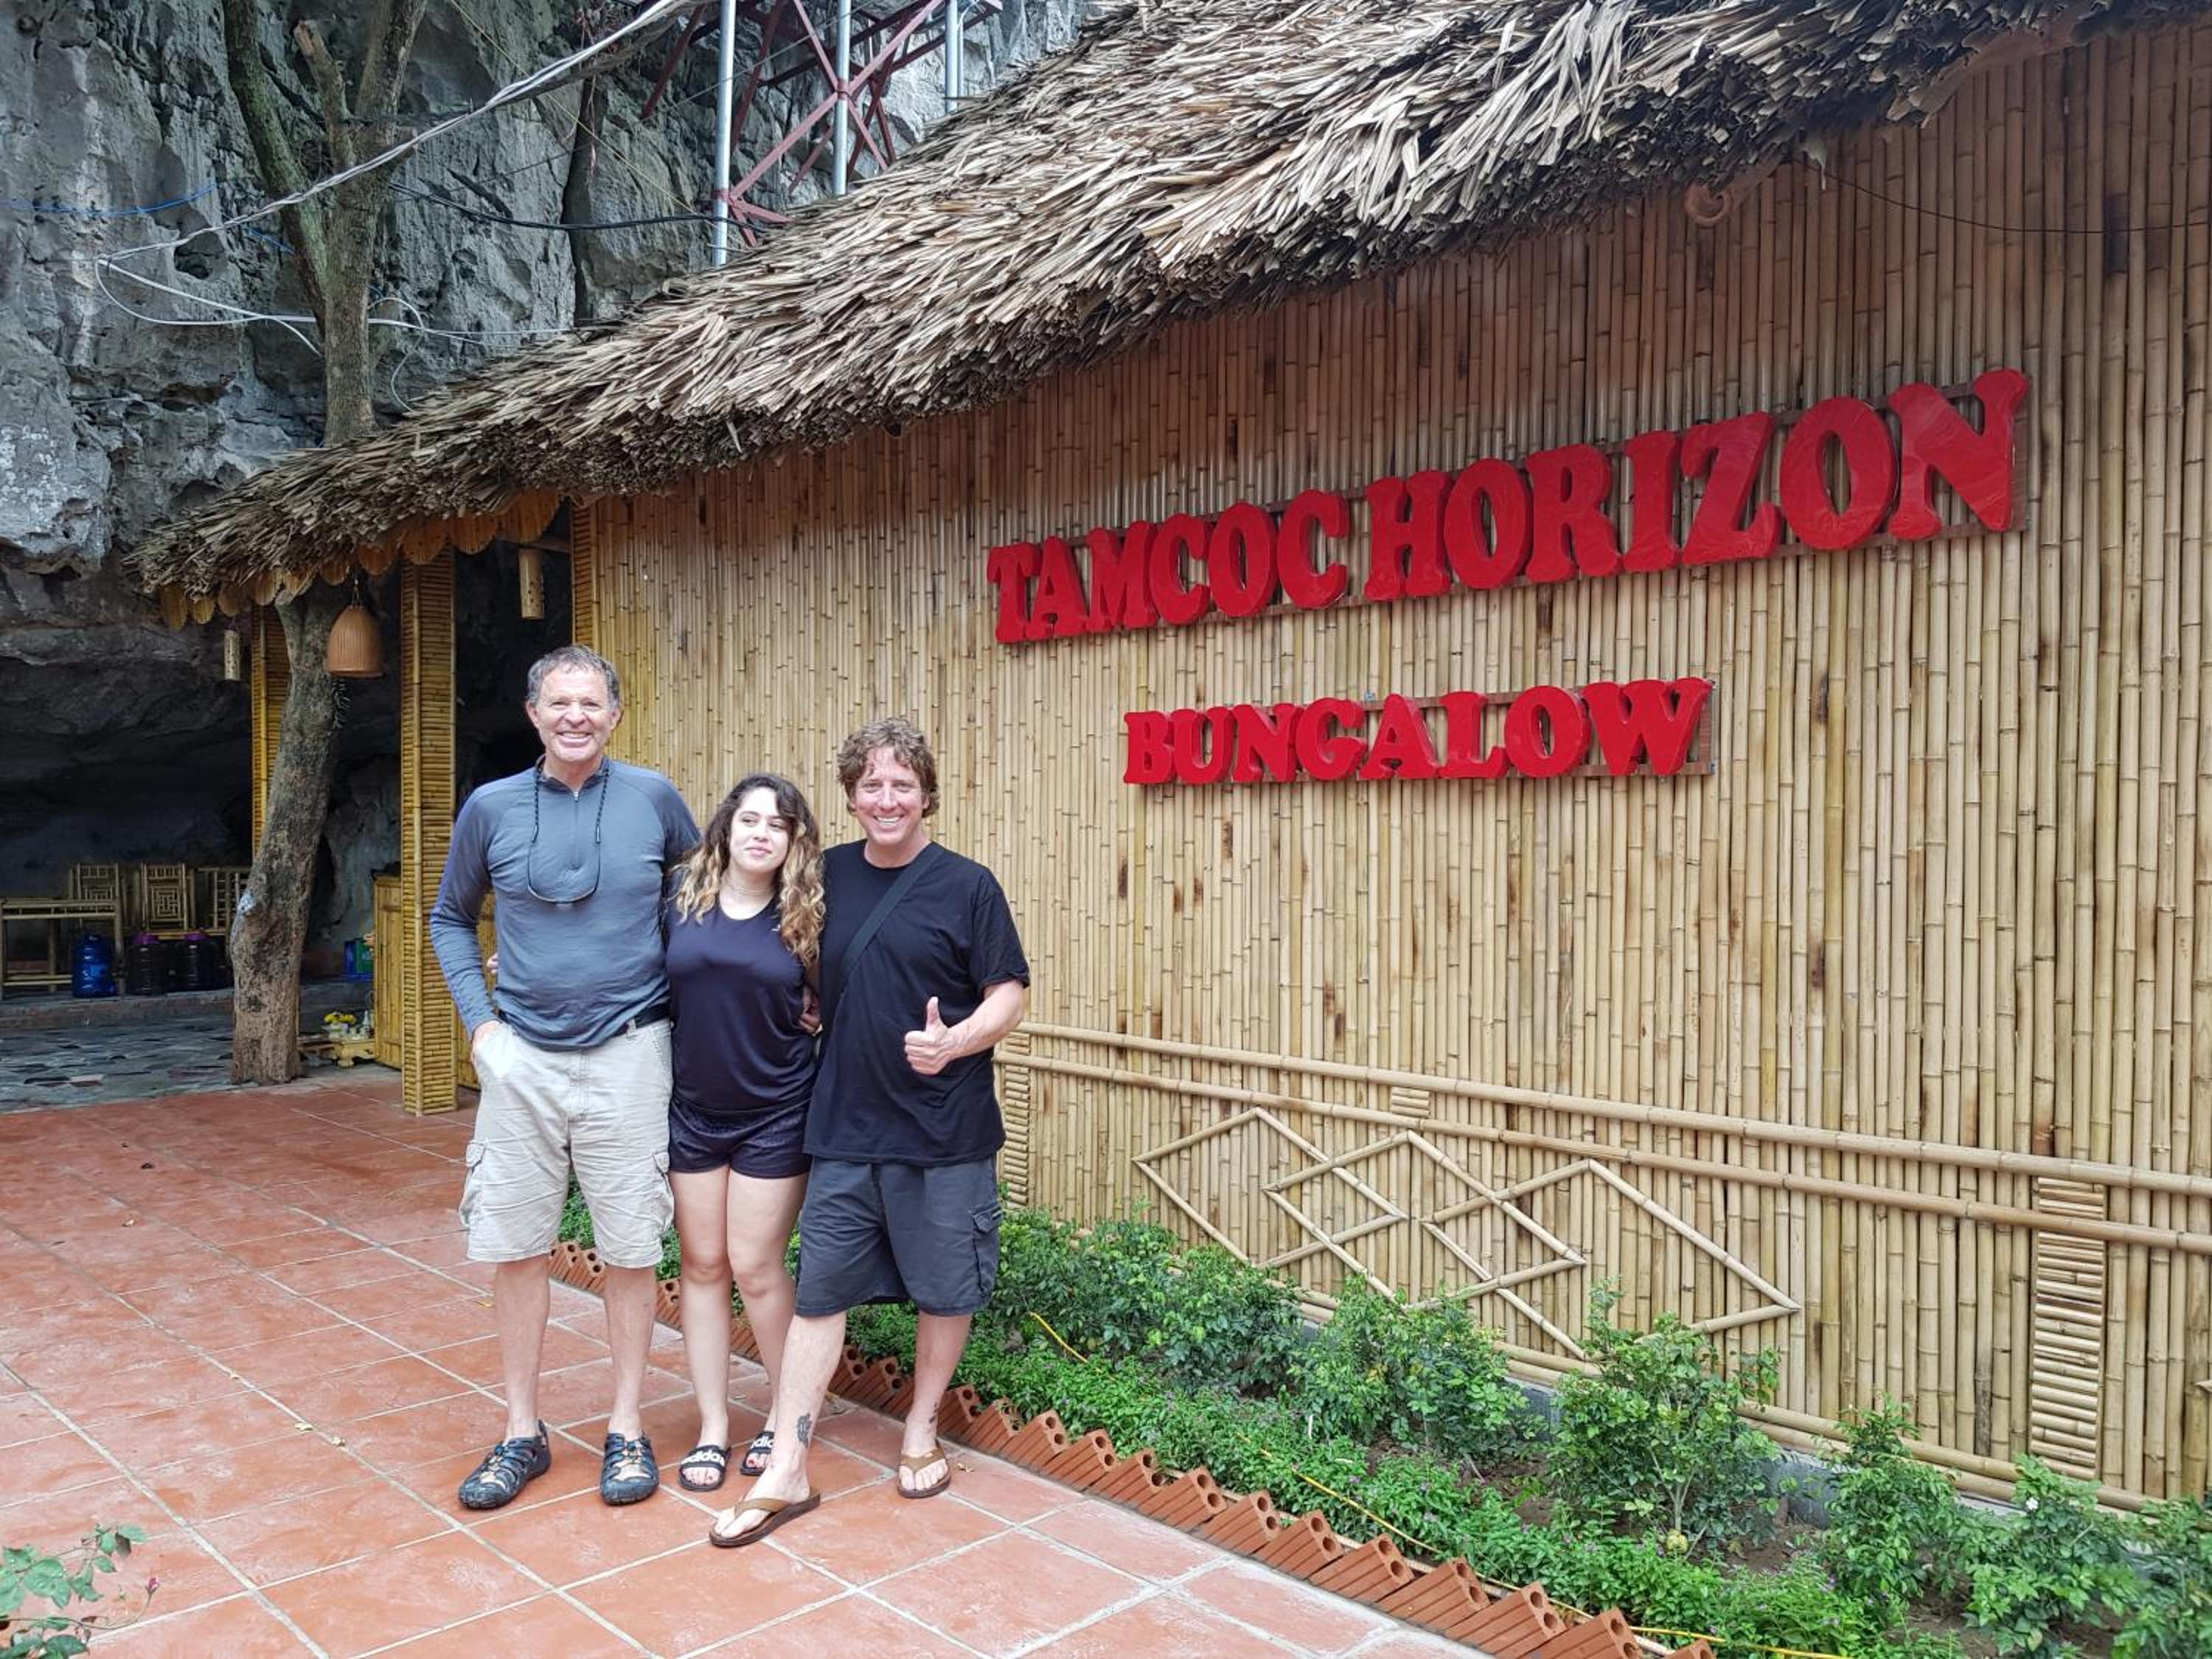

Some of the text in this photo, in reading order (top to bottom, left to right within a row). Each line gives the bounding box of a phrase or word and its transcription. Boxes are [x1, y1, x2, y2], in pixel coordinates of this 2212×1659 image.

[987, 368, 2028, 644] TAMCOC HORIZON
[1124, 678, 1711, 785] BUNGALOW
